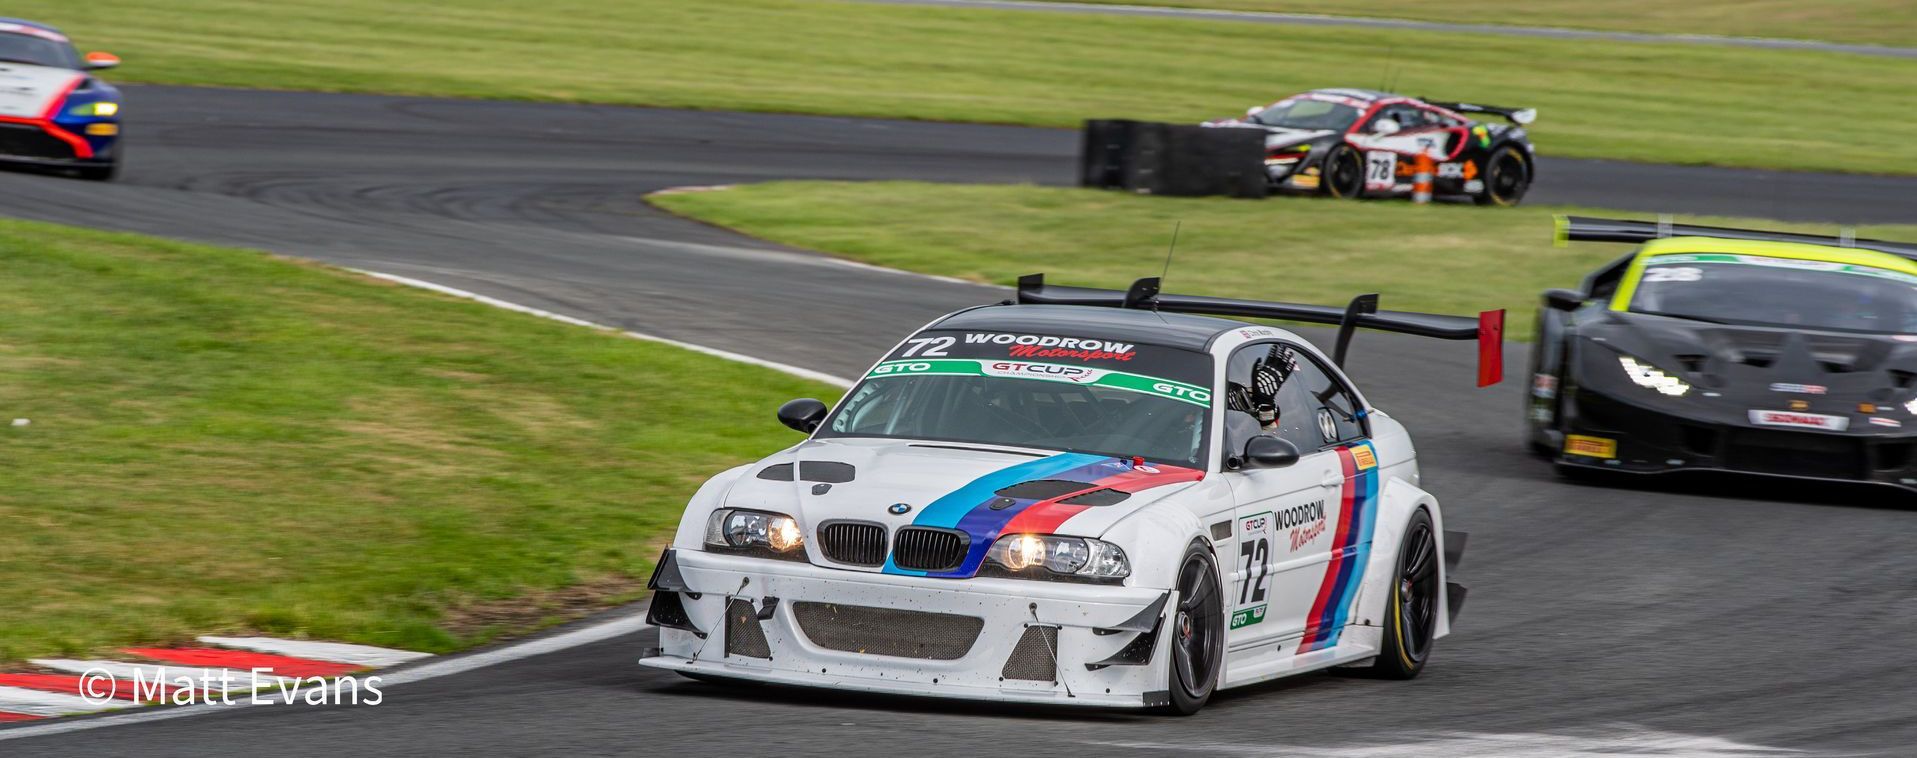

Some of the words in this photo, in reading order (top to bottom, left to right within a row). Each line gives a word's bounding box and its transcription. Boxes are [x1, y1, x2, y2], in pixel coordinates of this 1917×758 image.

[1371, 160, 1390, 179] 78
[902, 336, 956, 358] 72
[965, 333, 1134, 353] WOODROW
[1008, 344, 1136, 361] Motorsport
[874, 362, 931, 374] GTO
[1152, 382, 1211, 402] GTO
[1274, 500, 1325, 531] WOODROW
[1289, 513, 1326, 552] Motorsport
[1240, 538, 1269, 605] 72
[1232, 613, 1247, 627] GTO
